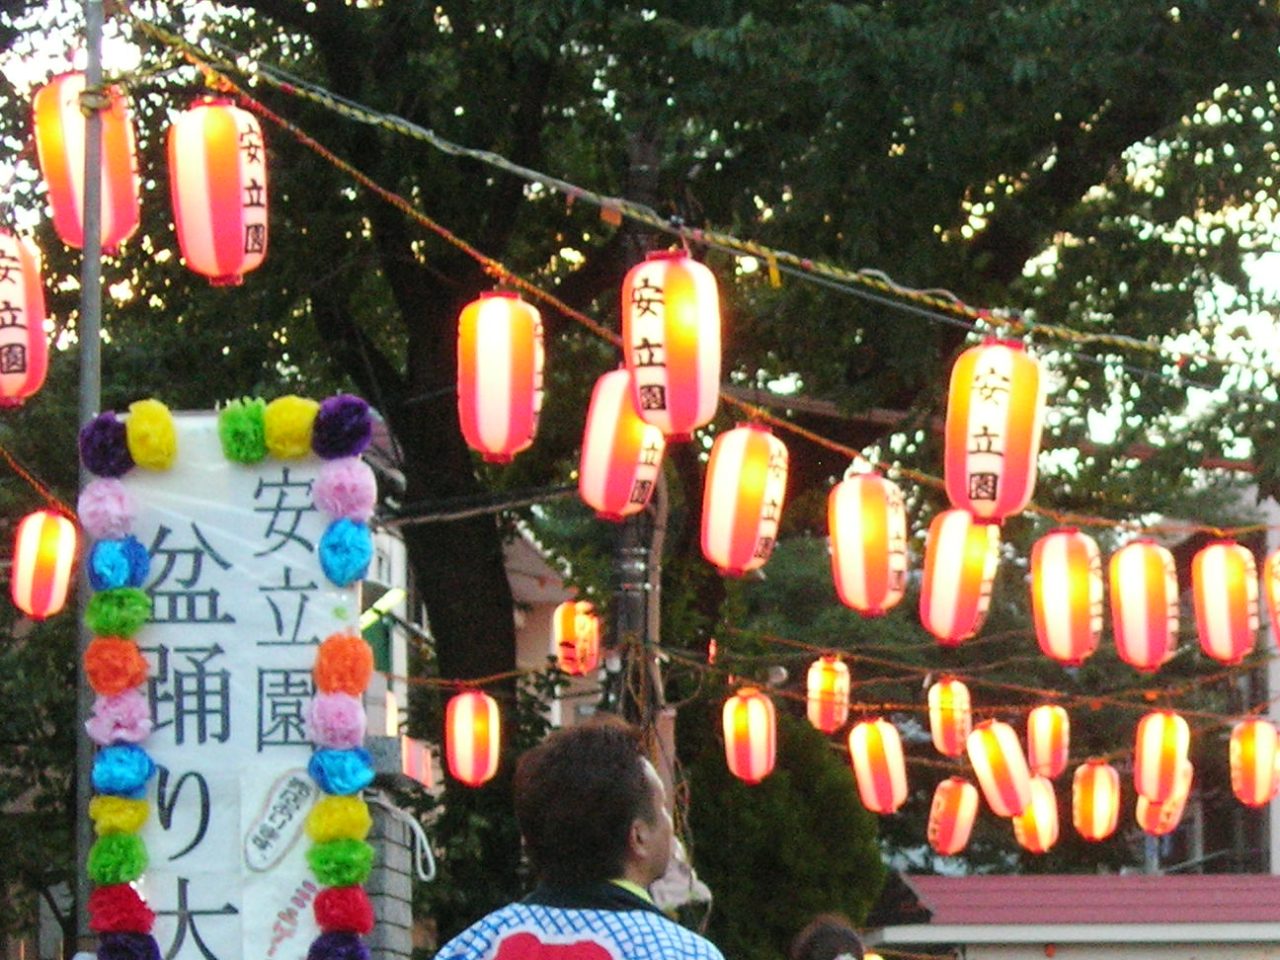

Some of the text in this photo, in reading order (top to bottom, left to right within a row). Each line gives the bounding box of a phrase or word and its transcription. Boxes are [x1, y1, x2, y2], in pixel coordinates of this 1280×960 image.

[240, 123, 266, 254] 安立園
[632, 277, 667, 411] 安立園
[969, 367, 1011, 501] 安立園
[754, 449, 788, 560] 安立園
[253, 466, 321, 753] 安立園
